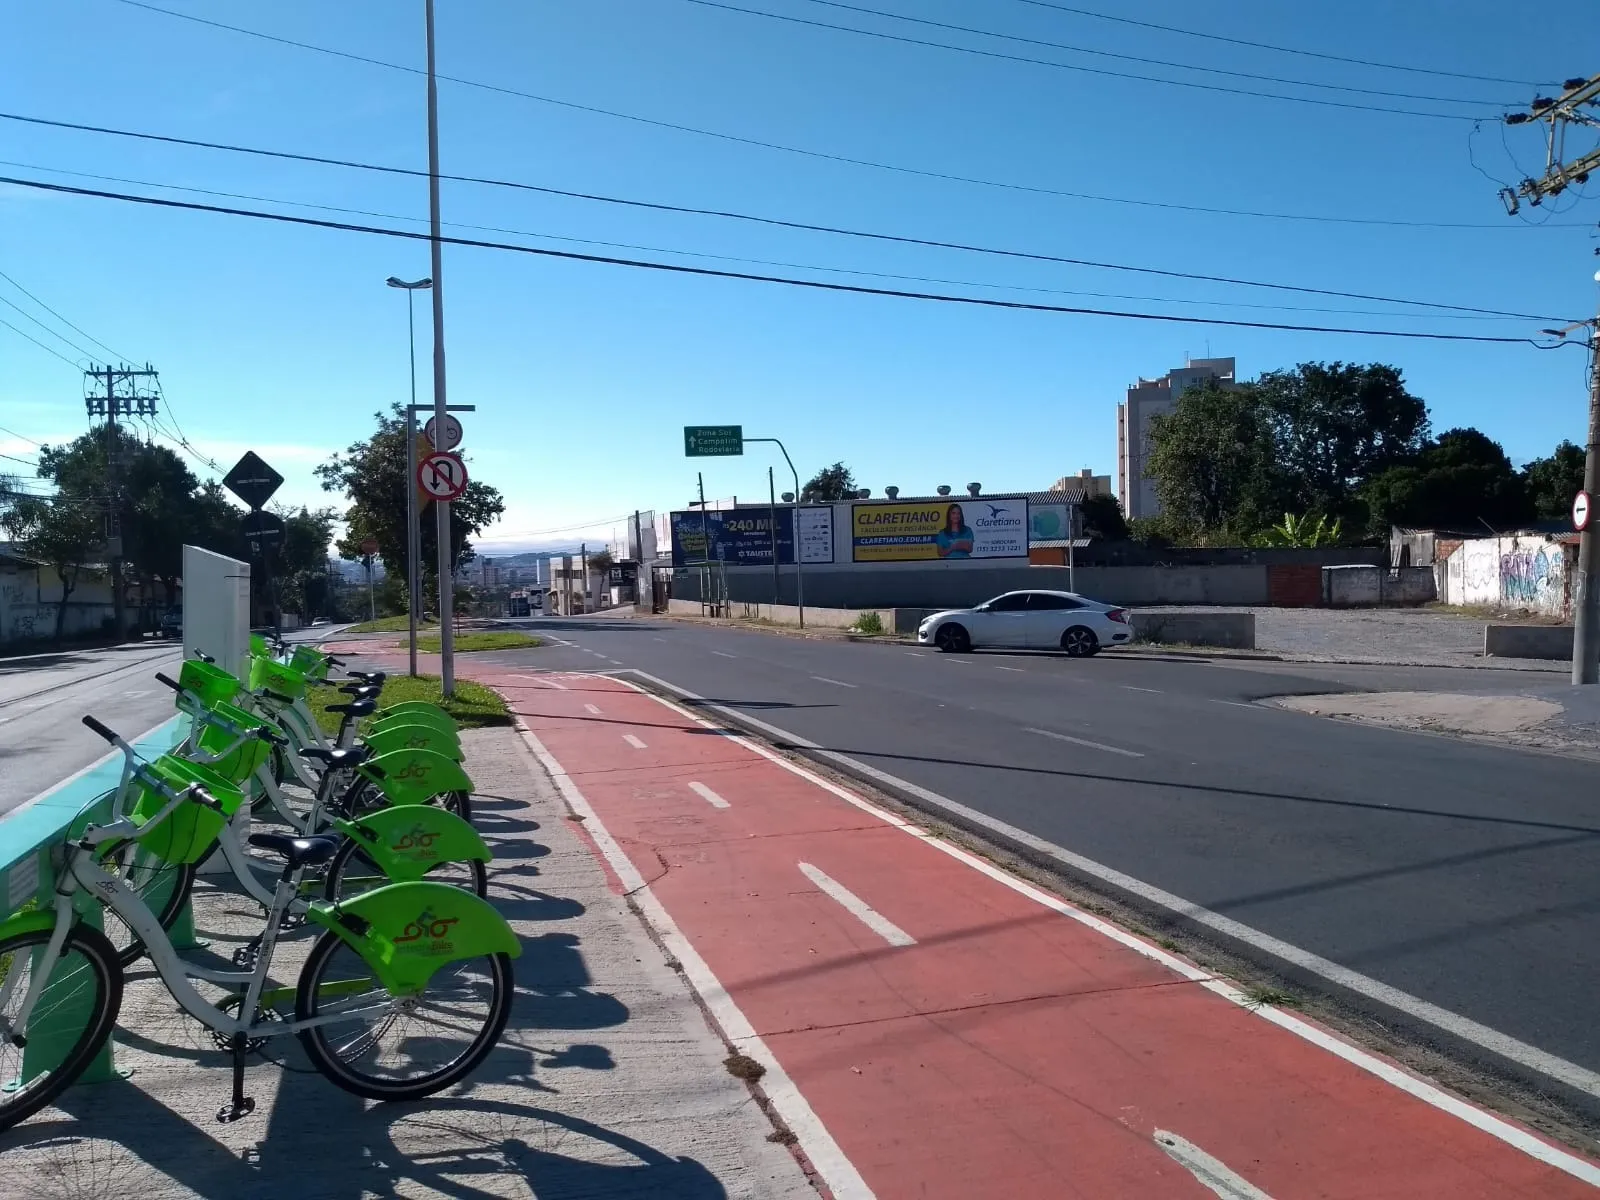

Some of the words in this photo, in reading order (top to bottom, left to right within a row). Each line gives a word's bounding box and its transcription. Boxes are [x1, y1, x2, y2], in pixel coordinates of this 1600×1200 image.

[698, 438, 738, 446] Campolim
[857, 510, 941, 525] CLARETIANO
[975, 517, 1021, 527] Claretiano
[729, 519, 754, 532] 240
[860, 535, 932, 545] CLARETIANO.EDU.BR
